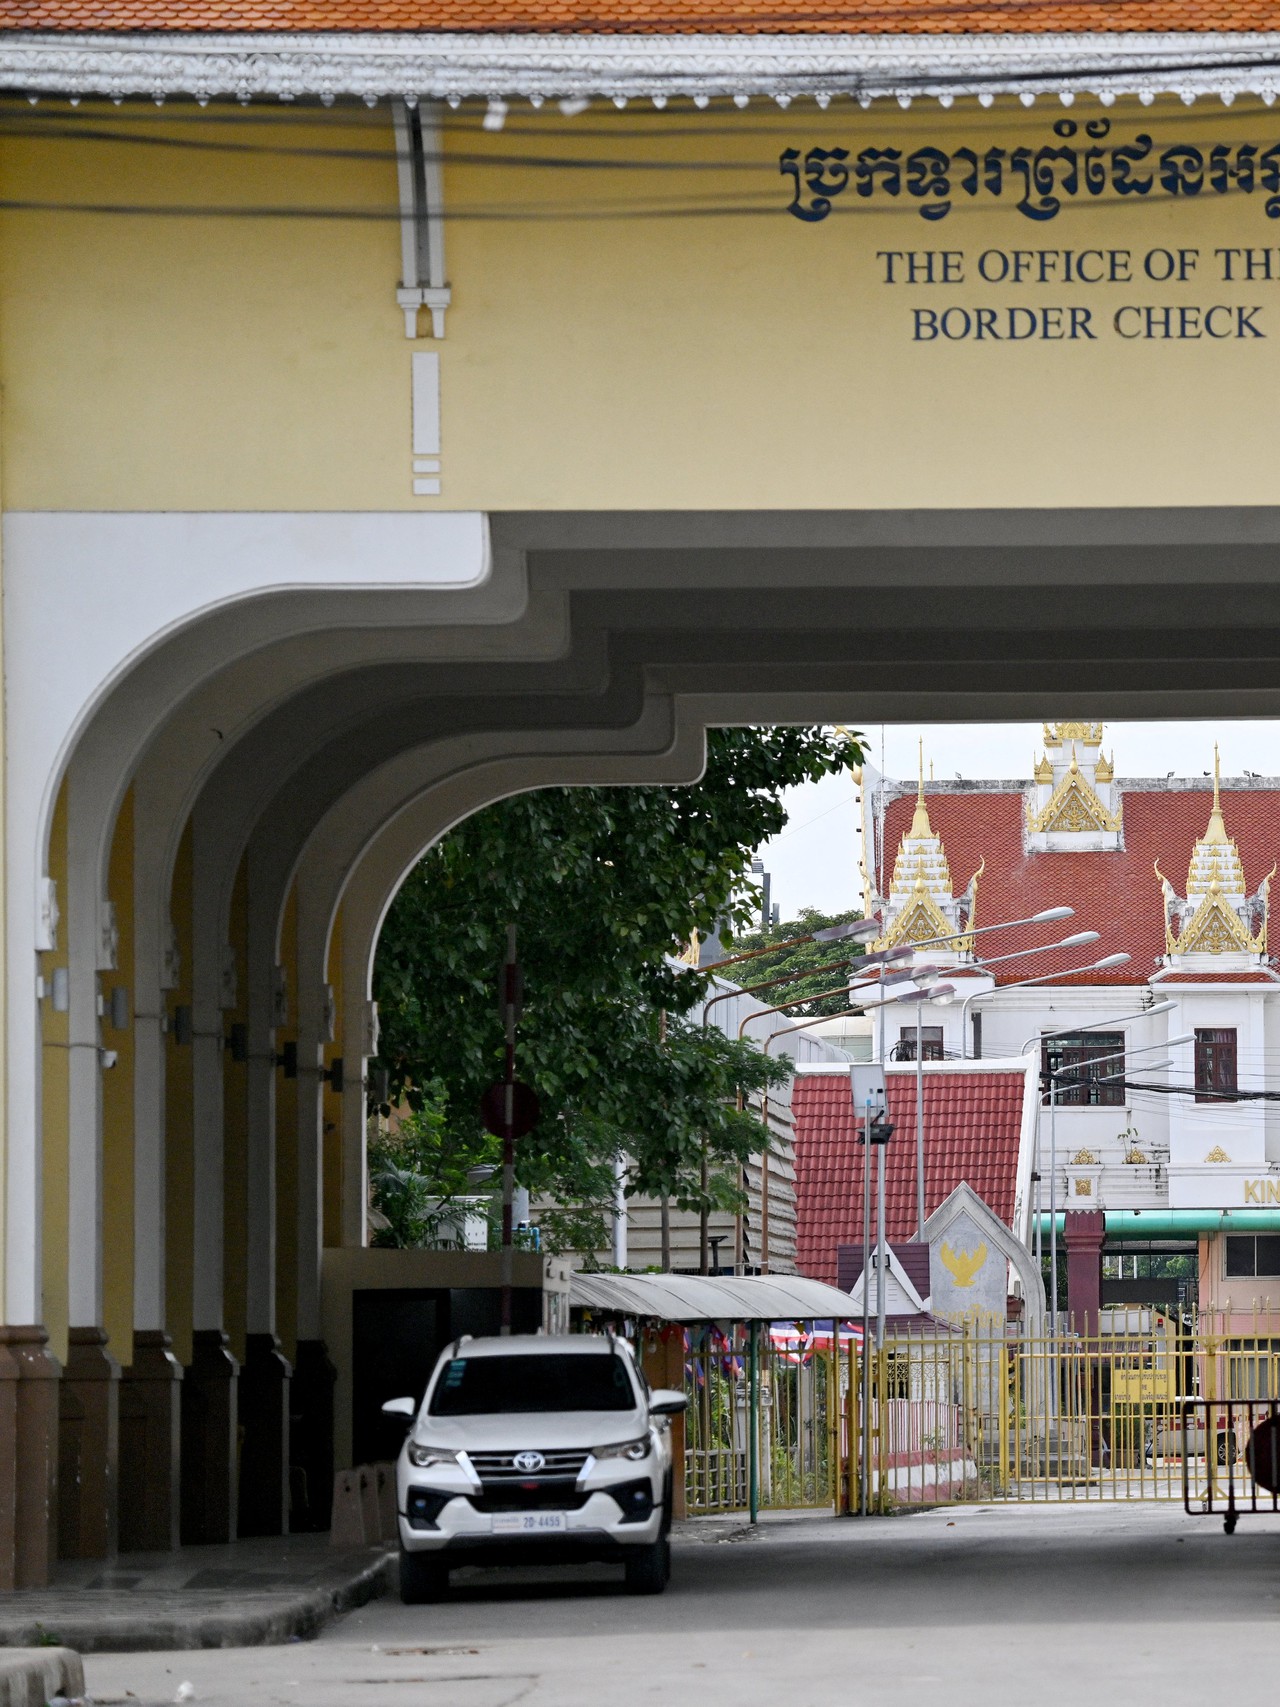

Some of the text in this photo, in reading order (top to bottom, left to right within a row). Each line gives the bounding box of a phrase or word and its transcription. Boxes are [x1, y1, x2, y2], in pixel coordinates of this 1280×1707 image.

[876, 251, 965, 285] THE
[977, 249, 1133, 284] OFFICE
[1144, 248, 1200, 282] OF
[911, 307, 1098, 342] BORDER
[1113, 305, 1266, 339] CHECK
